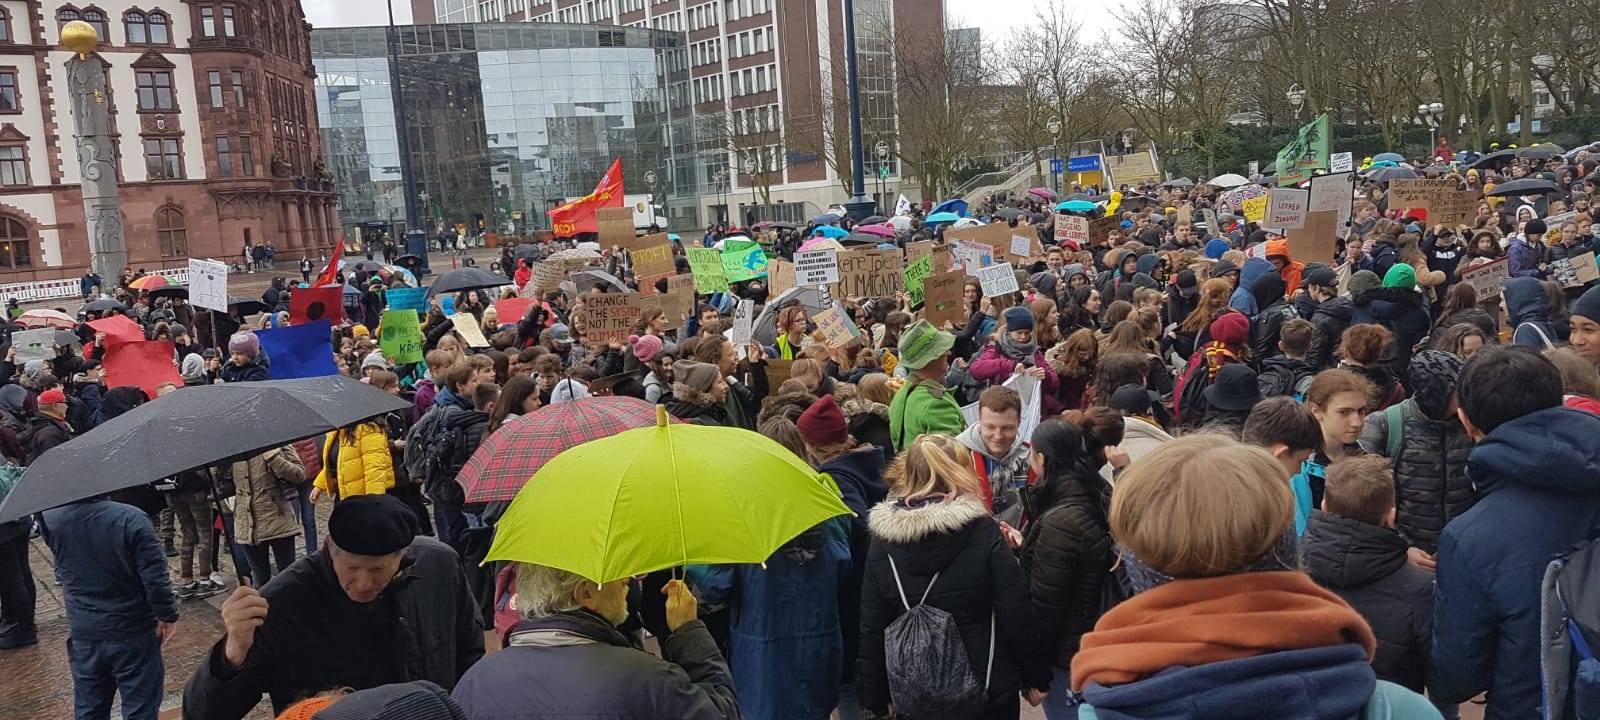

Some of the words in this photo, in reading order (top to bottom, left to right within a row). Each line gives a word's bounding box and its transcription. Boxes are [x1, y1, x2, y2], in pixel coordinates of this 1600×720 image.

[590, 295, 629, 308] CHANGE
[589, 308, 608, 319] THE
[610, 307, 641, 318] SYSTEM
[588, 319, 607, 329] NOT
[611, 317, 630, 328] THE
